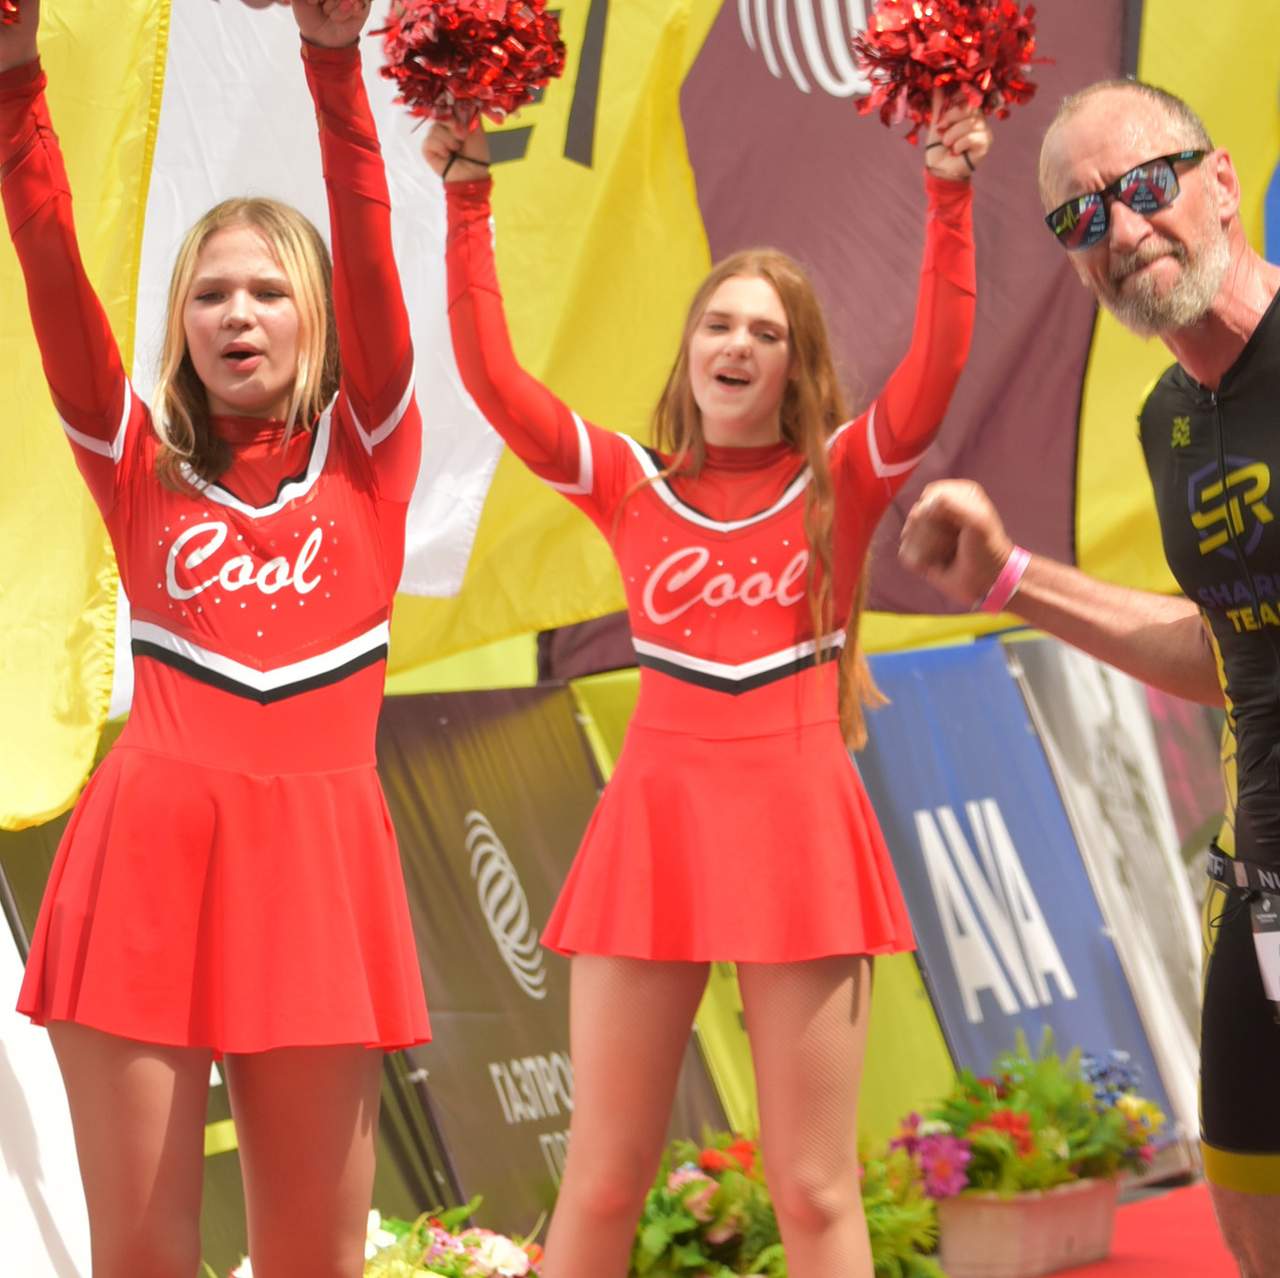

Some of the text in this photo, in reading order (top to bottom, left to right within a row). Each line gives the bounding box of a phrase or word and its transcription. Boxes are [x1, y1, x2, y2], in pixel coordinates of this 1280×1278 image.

[165, 521, 323, 601] Cool
[642, 545, 809, 624] Cool
[913, 797, 1077, 1024] AVA
